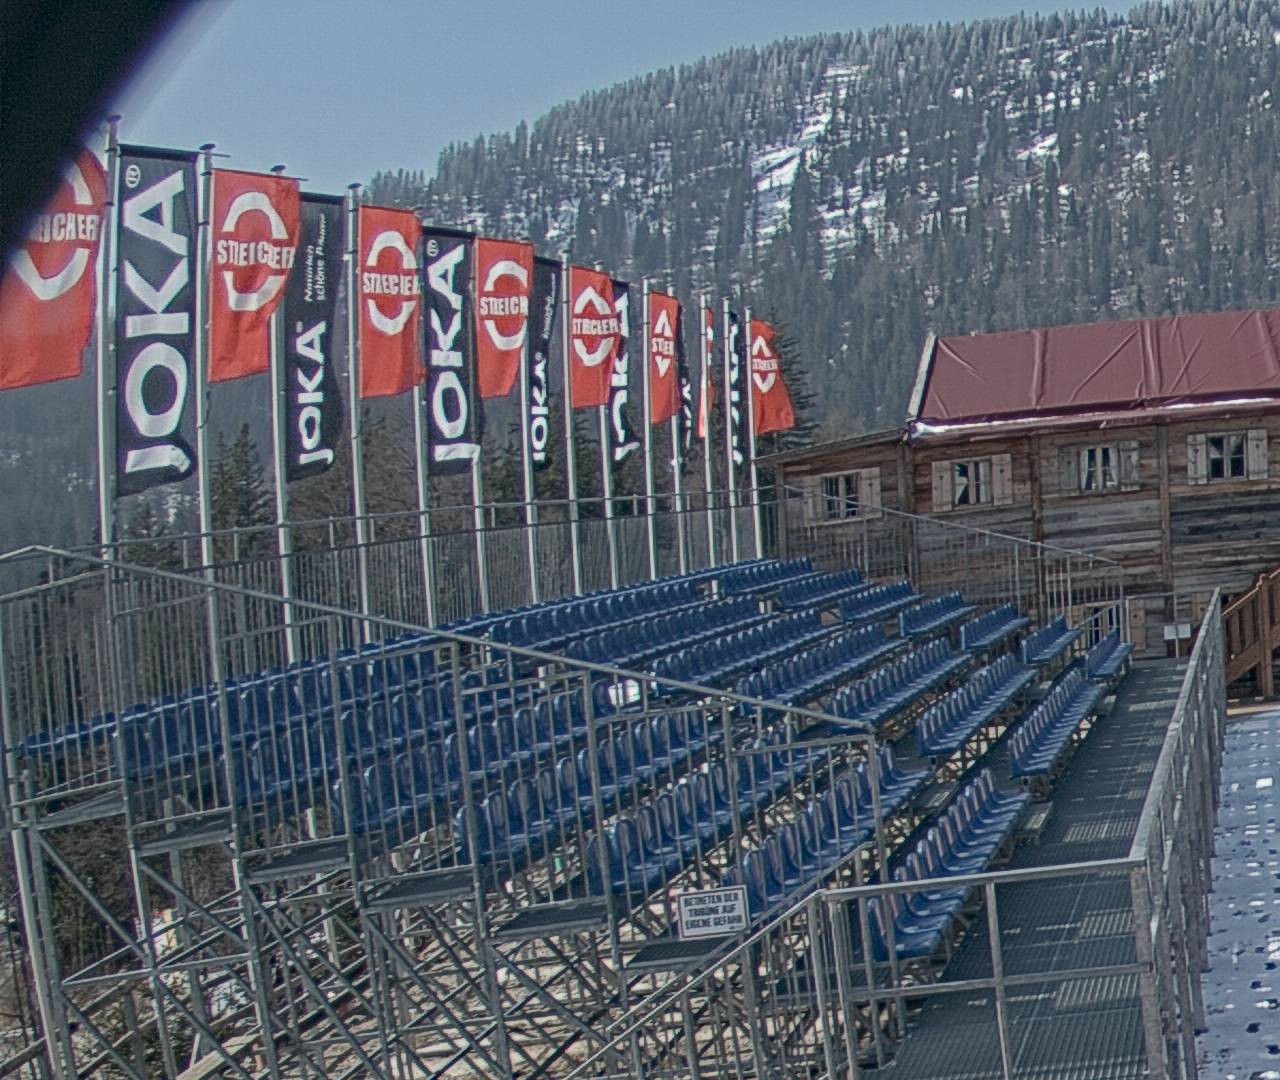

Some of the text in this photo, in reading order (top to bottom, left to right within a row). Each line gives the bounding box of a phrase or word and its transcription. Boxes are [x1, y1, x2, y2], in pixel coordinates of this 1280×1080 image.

[123, 170, 191, 474] JOKA
[296, 320, 335, 465] JOKA
[427, 243, 481, 463] JOKA
